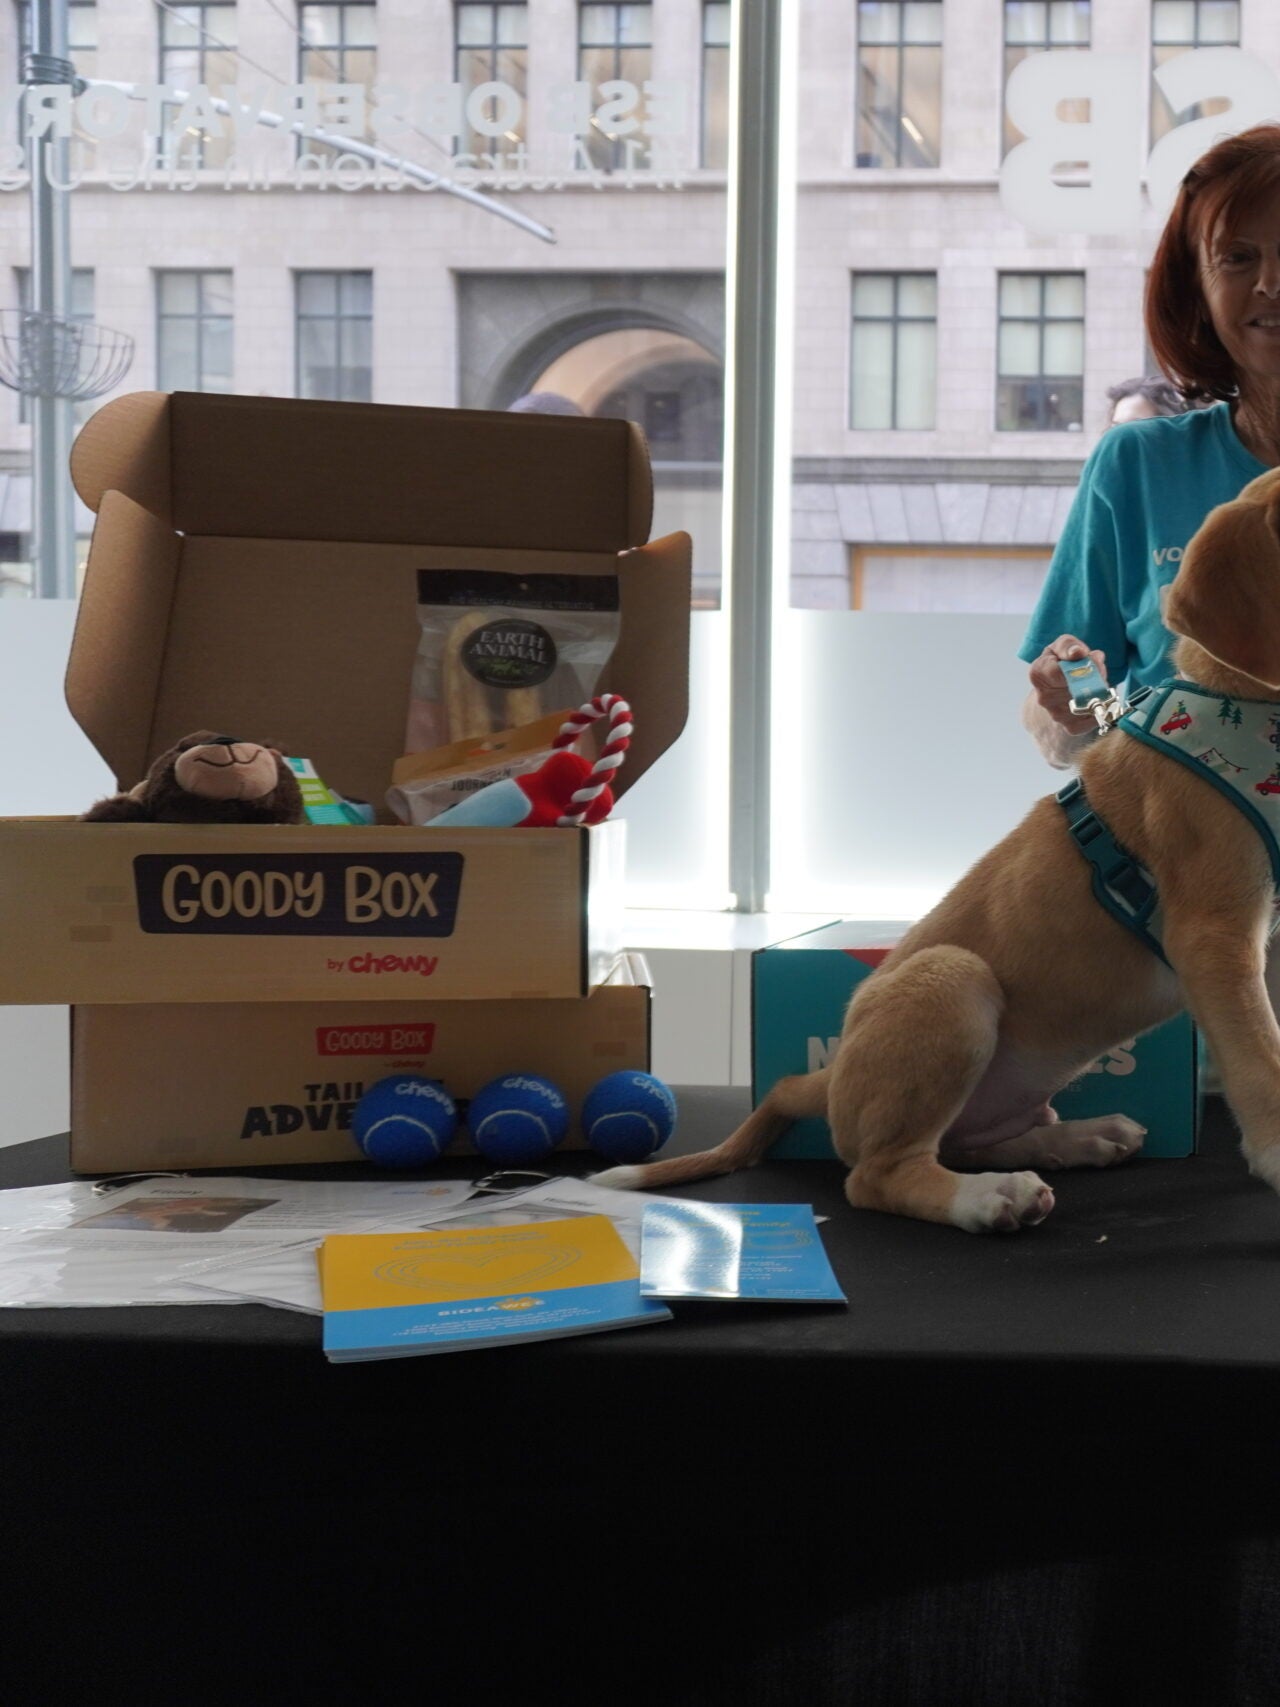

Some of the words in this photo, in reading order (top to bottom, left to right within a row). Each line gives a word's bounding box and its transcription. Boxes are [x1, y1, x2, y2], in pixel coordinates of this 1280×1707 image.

[480, 631, 545, 650] EARTH
[469, 643, 548, 665] ANIMAL
[162, 863, 324, 924] GOODY
[344, 864, 440, 925] BOX
[326, 956, 345, 974] by
[347, 951, 439, 977] chewy
[325, 1030, 385, 1052] GOODY
[390, 1028, 428, 1051] BOX
[304, 1082, 365, 1103] TAIL
[240, 1103, 357, 1140] ADVE
